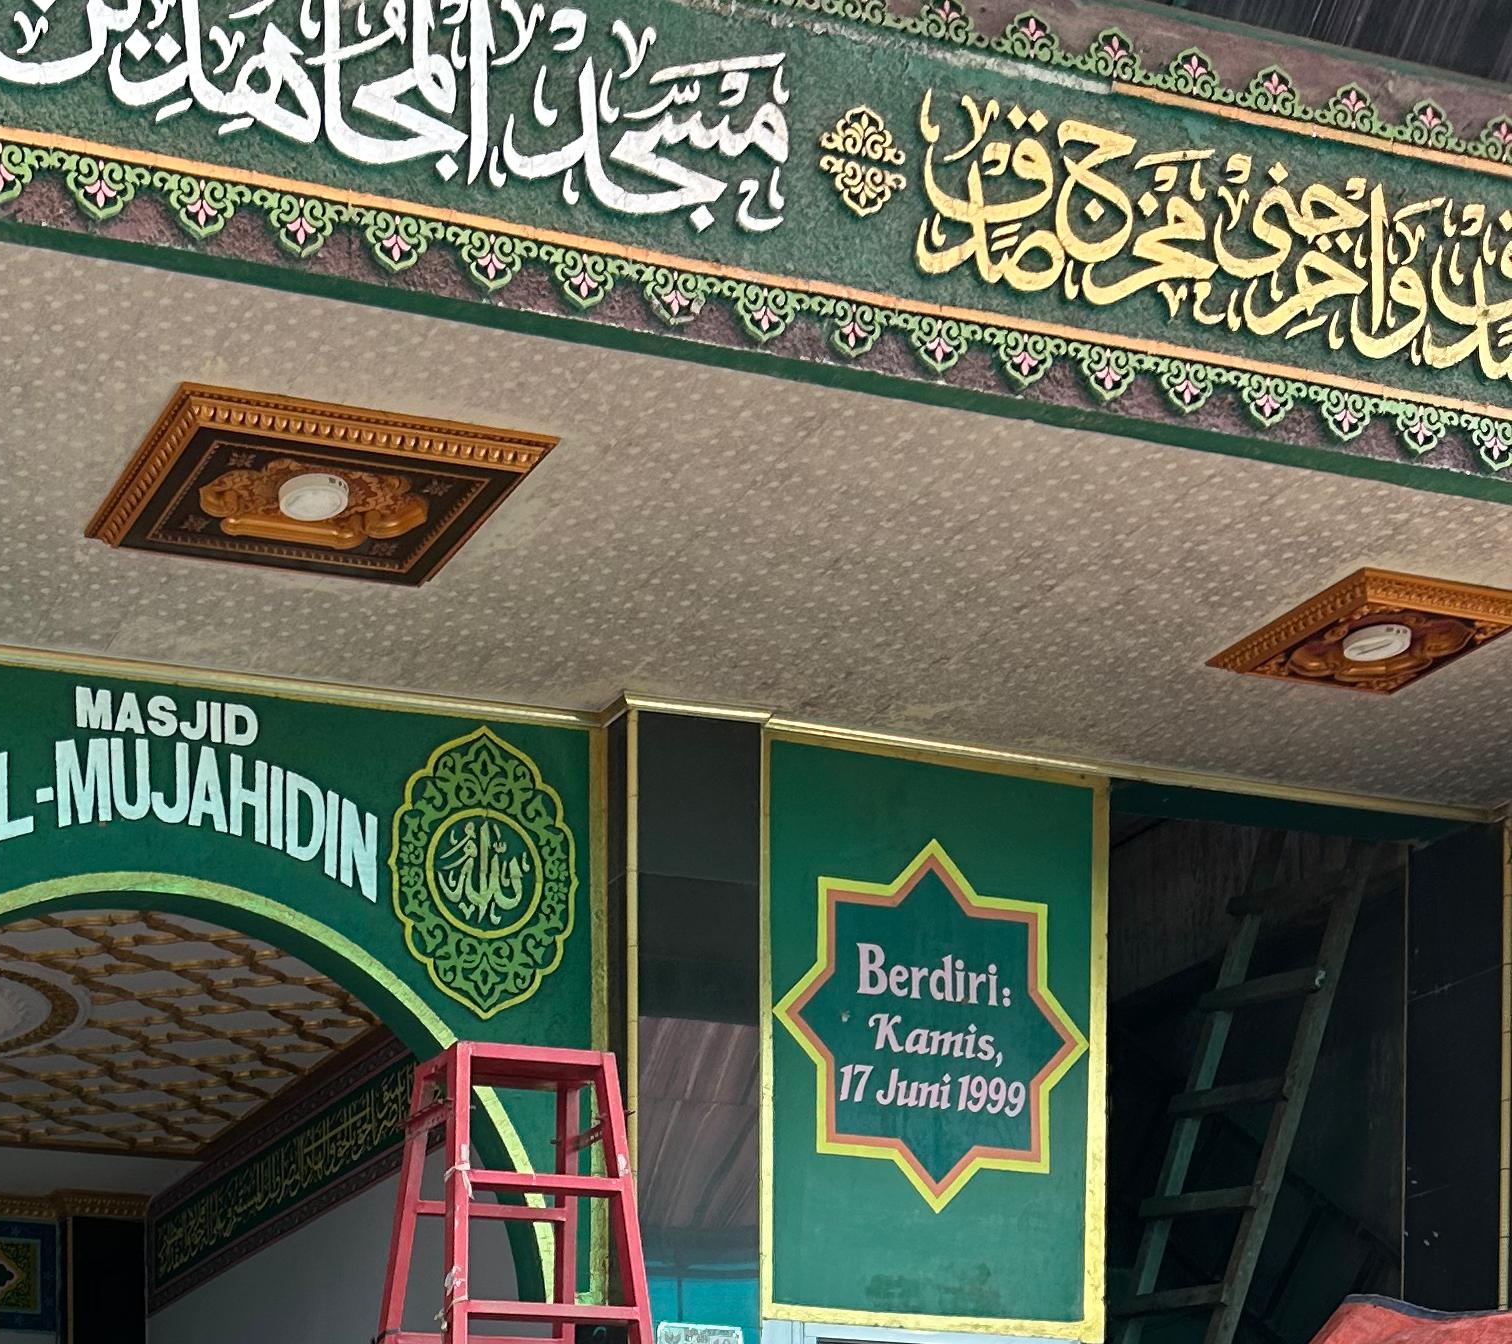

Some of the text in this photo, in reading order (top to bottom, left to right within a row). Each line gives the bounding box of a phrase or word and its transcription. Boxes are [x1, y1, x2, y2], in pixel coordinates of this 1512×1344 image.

[75, 685, 259, 748] MASJID
[856, 942, 1013, 1009] Berdiri:
[868, 1013, 1004, 1067] Kamis,
[839, 1064, 1027, 1118] 17 Juni 1999
